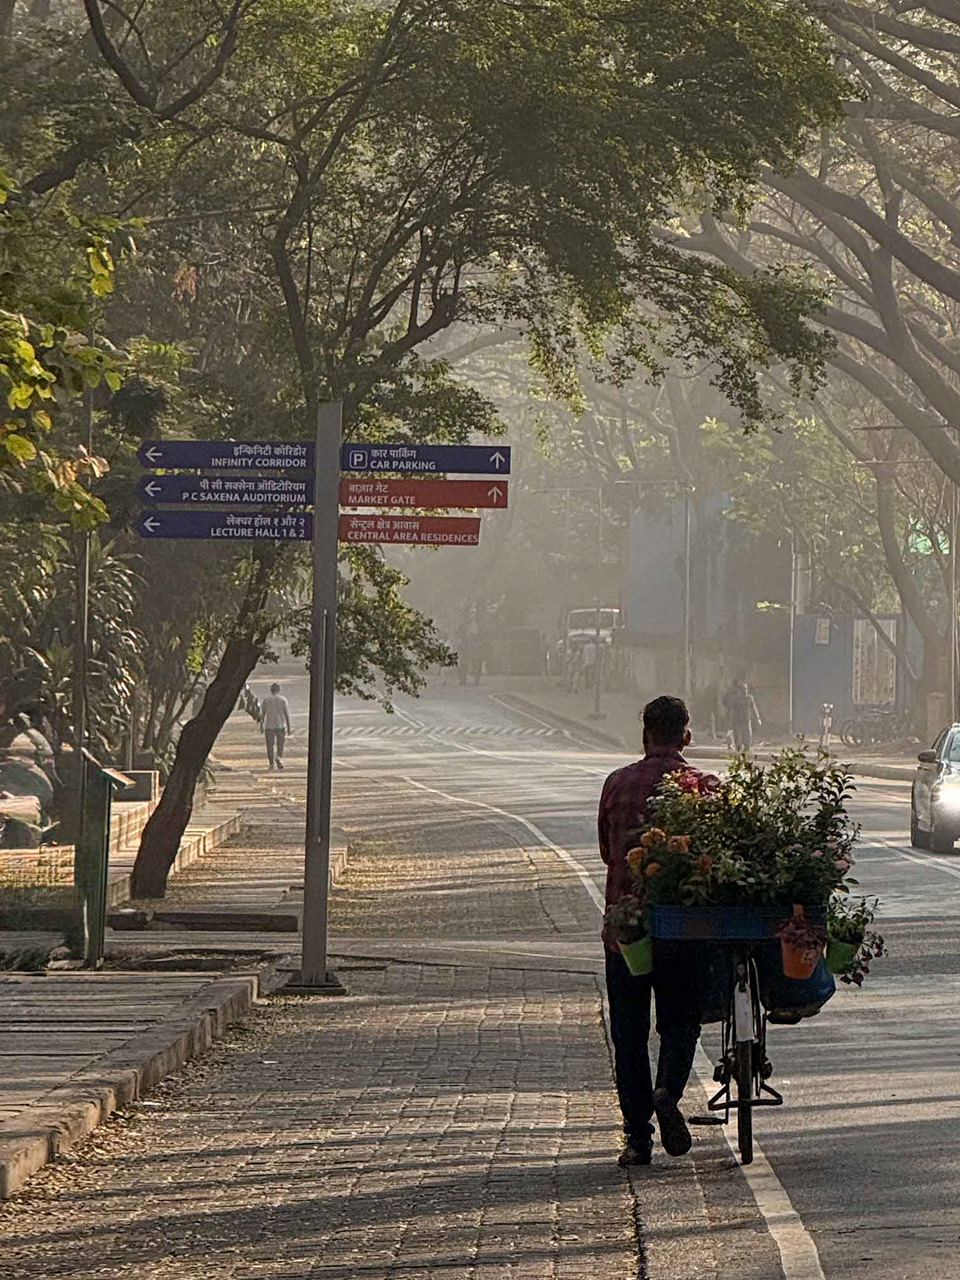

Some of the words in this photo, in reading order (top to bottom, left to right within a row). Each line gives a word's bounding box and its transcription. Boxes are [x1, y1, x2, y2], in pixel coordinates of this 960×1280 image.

[371, 449, 387, 458] कार
[211, 458, 253, 466] INFINITY
[256, 458, 307, 467] CORRIDOR
[370, 461, 390, 469] CAR
[393, 461, 436, 470] PARKING
[200, 479, 209, 489] पी
[212, 480, 222, 490] सी
[376, 482, 388, 493] गेट
[200, 493, 240, 501] SAXENA
[243, 493, 306, 502] AUDITORIUM
[349, 496, 388, 504] MARKET
[254, 515, 270, 526] हॉल
[281, 516, 296, 526] और
[393, 522, 419, 530] आवास
[211, 528, 253, 536] LECTURE
[256, 529, 280, 537] HALL
[283, 529, 287, 537] 1
[289, 529, 297, 537] &
[299, 529, 305, 537] 2
[348, 531, 390, 540] CENTRAL
[421, 533, 479, 542] RESIDENCES
